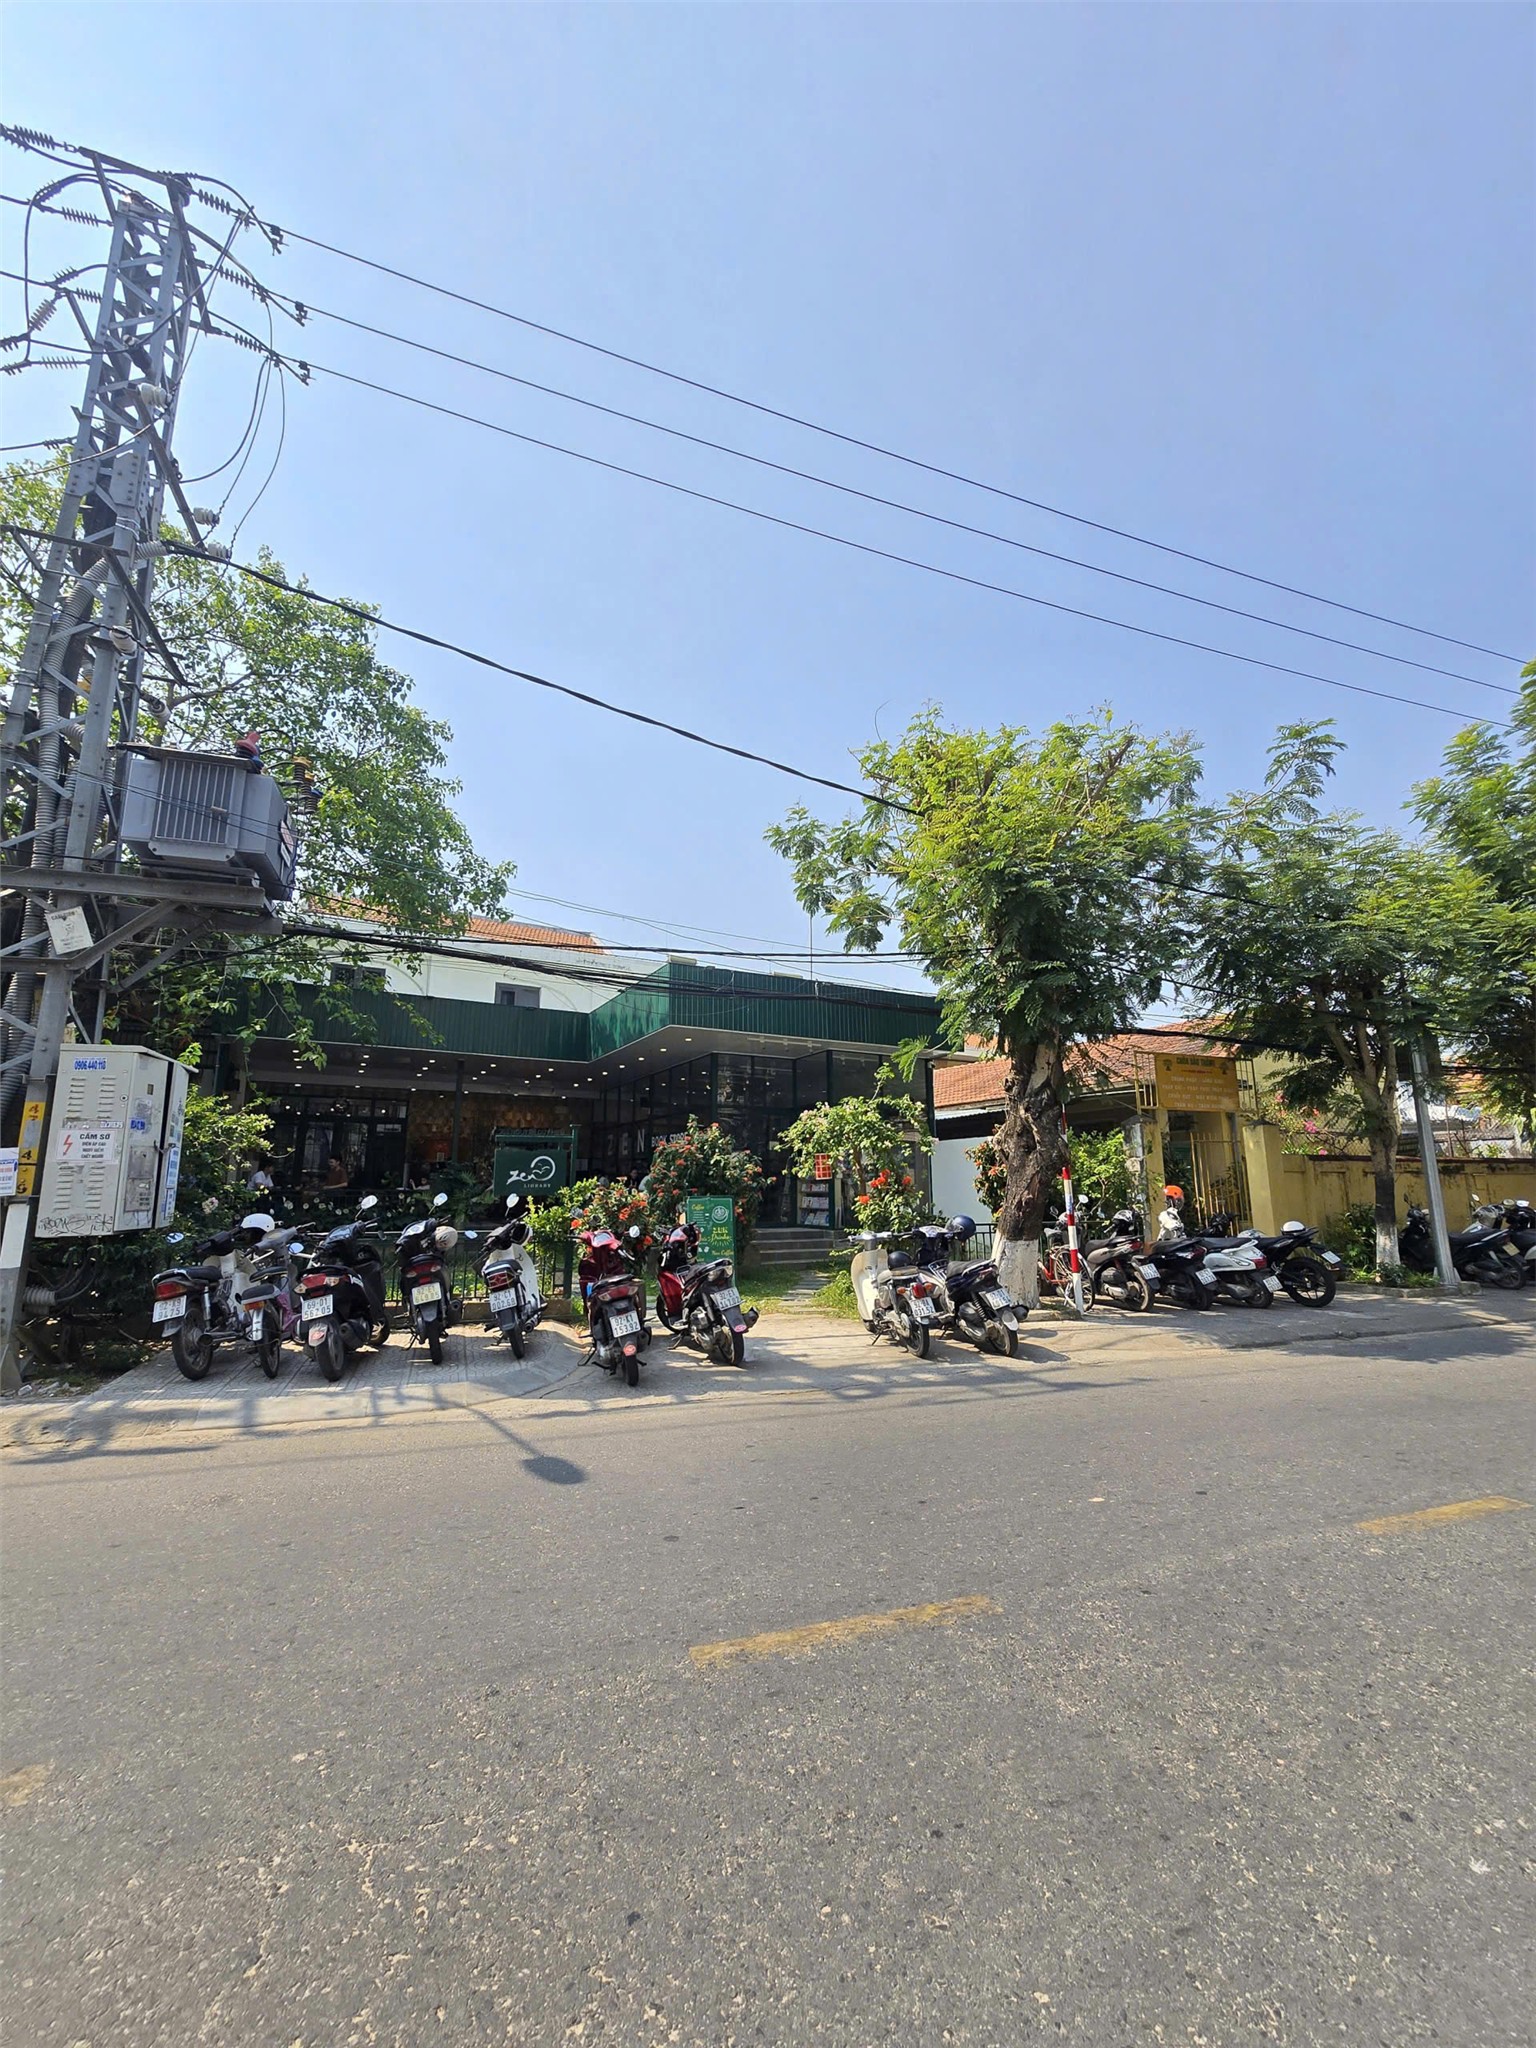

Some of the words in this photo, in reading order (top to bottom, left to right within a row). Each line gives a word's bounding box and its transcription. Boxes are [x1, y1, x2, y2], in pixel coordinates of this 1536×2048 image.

[21, 1150, 32, 1160] 4
[615, 1314, 634, 1327] 92-K1
[614, 1323, 640, 1336] 153.92
